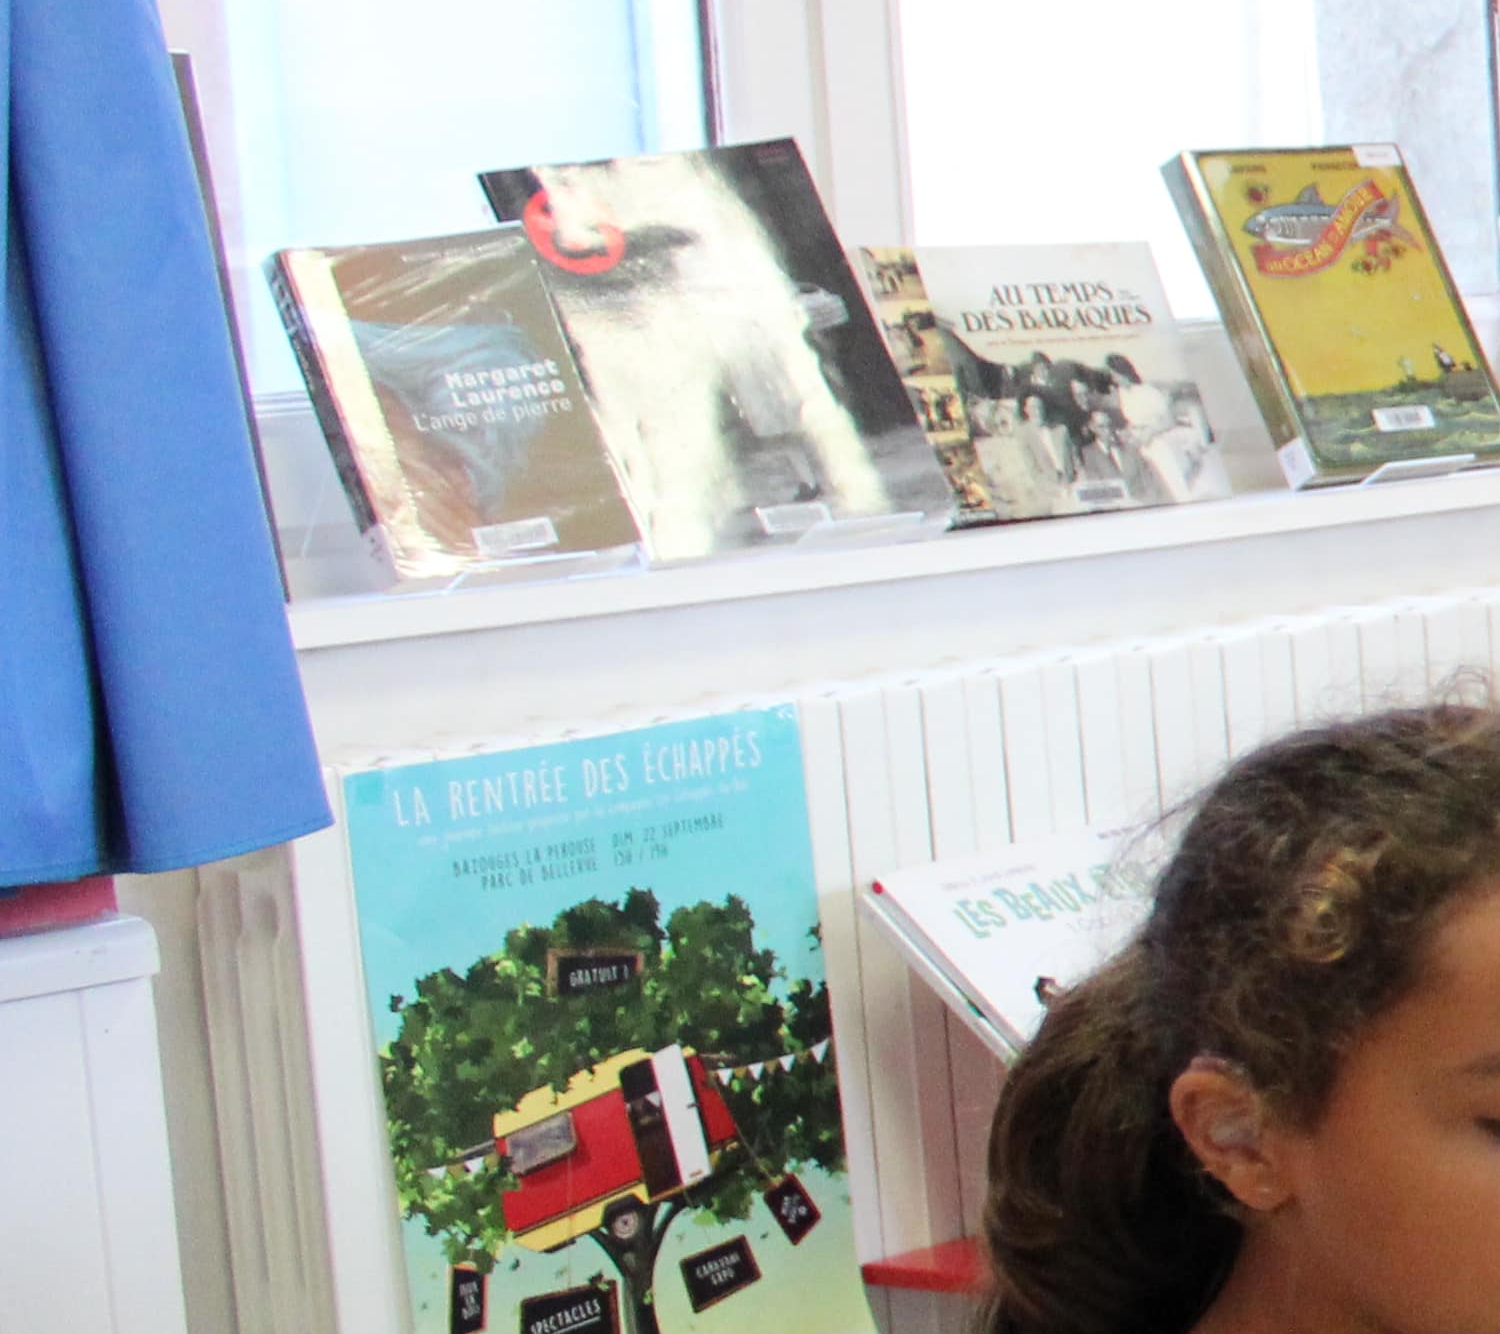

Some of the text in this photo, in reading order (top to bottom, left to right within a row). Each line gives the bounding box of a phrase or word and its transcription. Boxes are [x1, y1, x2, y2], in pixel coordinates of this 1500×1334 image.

[989, 280, 1115, 307] AU TEMPS
[961, 303, 1153, 332] DES BARAQUES
[444, 358, 560, 389] Margaret
[451, 378, 566, 408] Laurence
[413, 396, 573, 433] L'ange de pierre
[393, 786, 432, 828] LA
[448, 760, 568, 821] RENTRÉE
[582, 752, 630, 799] DES
[643, 727, 763, 785] ÉCHAPPÉS
[661, 813, 725, 840] SEPTEMBRE
[452, 852, 520, 878] BAZOUGES
[526, 847, 543, 867] LA
[481, 872, 513, 892] PARC
[519, 867, 535, 885] DE
